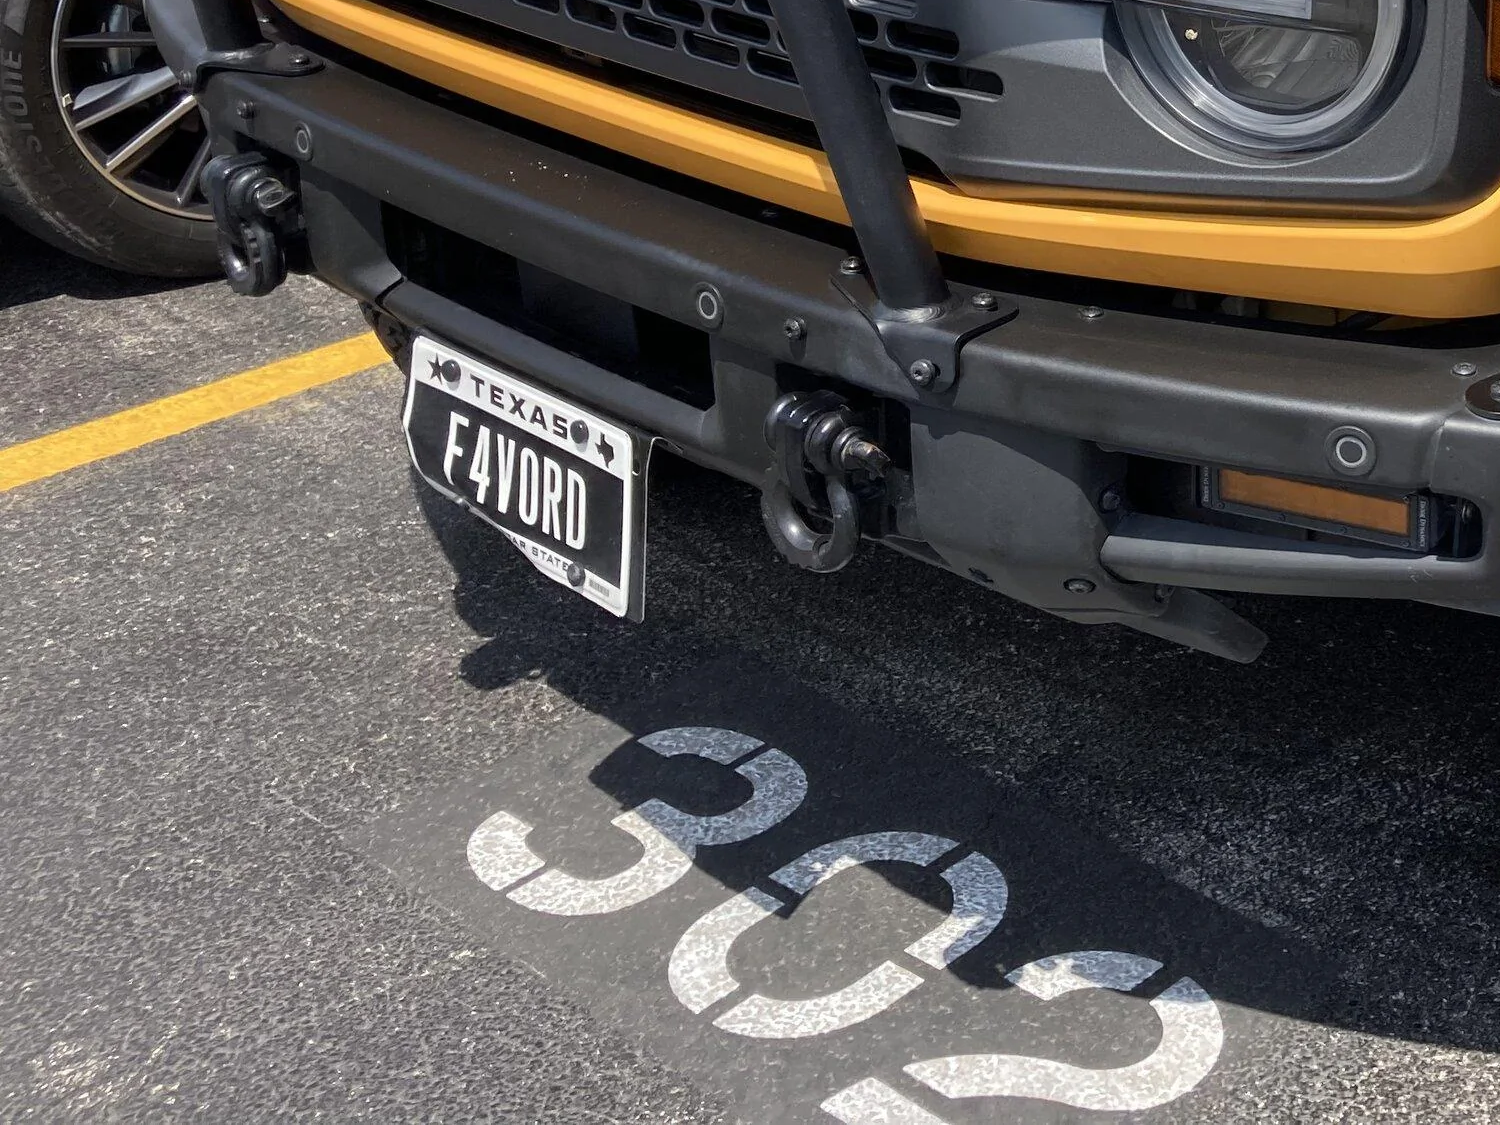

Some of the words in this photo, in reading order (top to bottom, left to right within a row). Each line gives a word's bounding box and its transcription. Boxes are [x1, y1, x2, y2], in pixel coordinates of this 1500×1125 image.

[470, 374, 568, 440] TEXAS
[443, 411, 586, 551] F4VORD
[531, 546, 569, 572] STATE
[466, 726, 1224, 1125] 302
